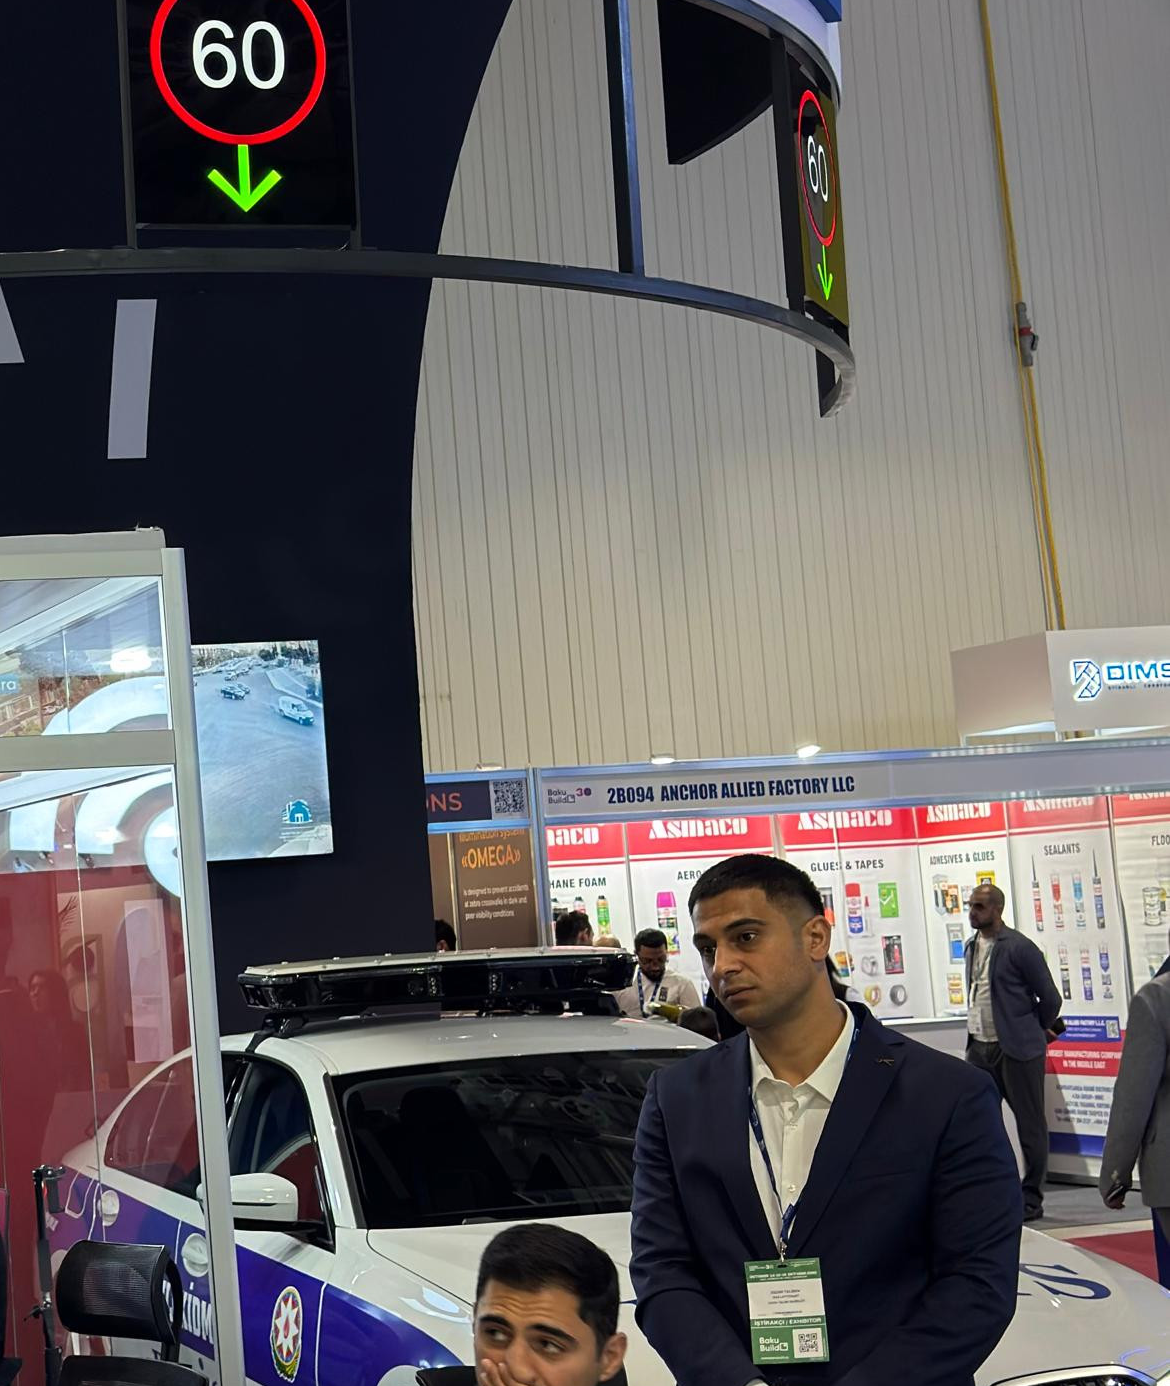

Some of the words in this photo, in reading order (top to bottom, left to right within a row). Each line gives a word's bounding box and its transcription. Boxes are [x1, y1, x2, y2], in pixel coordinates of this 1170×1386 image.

[191, 19, 286, 90] 60
[807, 134, 829, 203] 60
[607, 786, 654, 804] 2B094
[661, 784, 717, 802] ANCHOR
[721, 781, 765, 799] ALLIED
[768, 778, 828, 797] FACTORY
[832, 776, 855, 793] LLC
[1044, 843, 1080, 856] SEALANTS
[973, 850, 995, 862] GLUES
[810, 861, 842, 873] GLUES
[845, 860, 852, 869] &
[855, 859, 884, 870] TAPES
[677, 869, 703, 881] AERO
[579, 877, 607, 887] FOAM
[759, 1336, 779, 1344] Baku
[759, 1343, 780, 1351] Build
